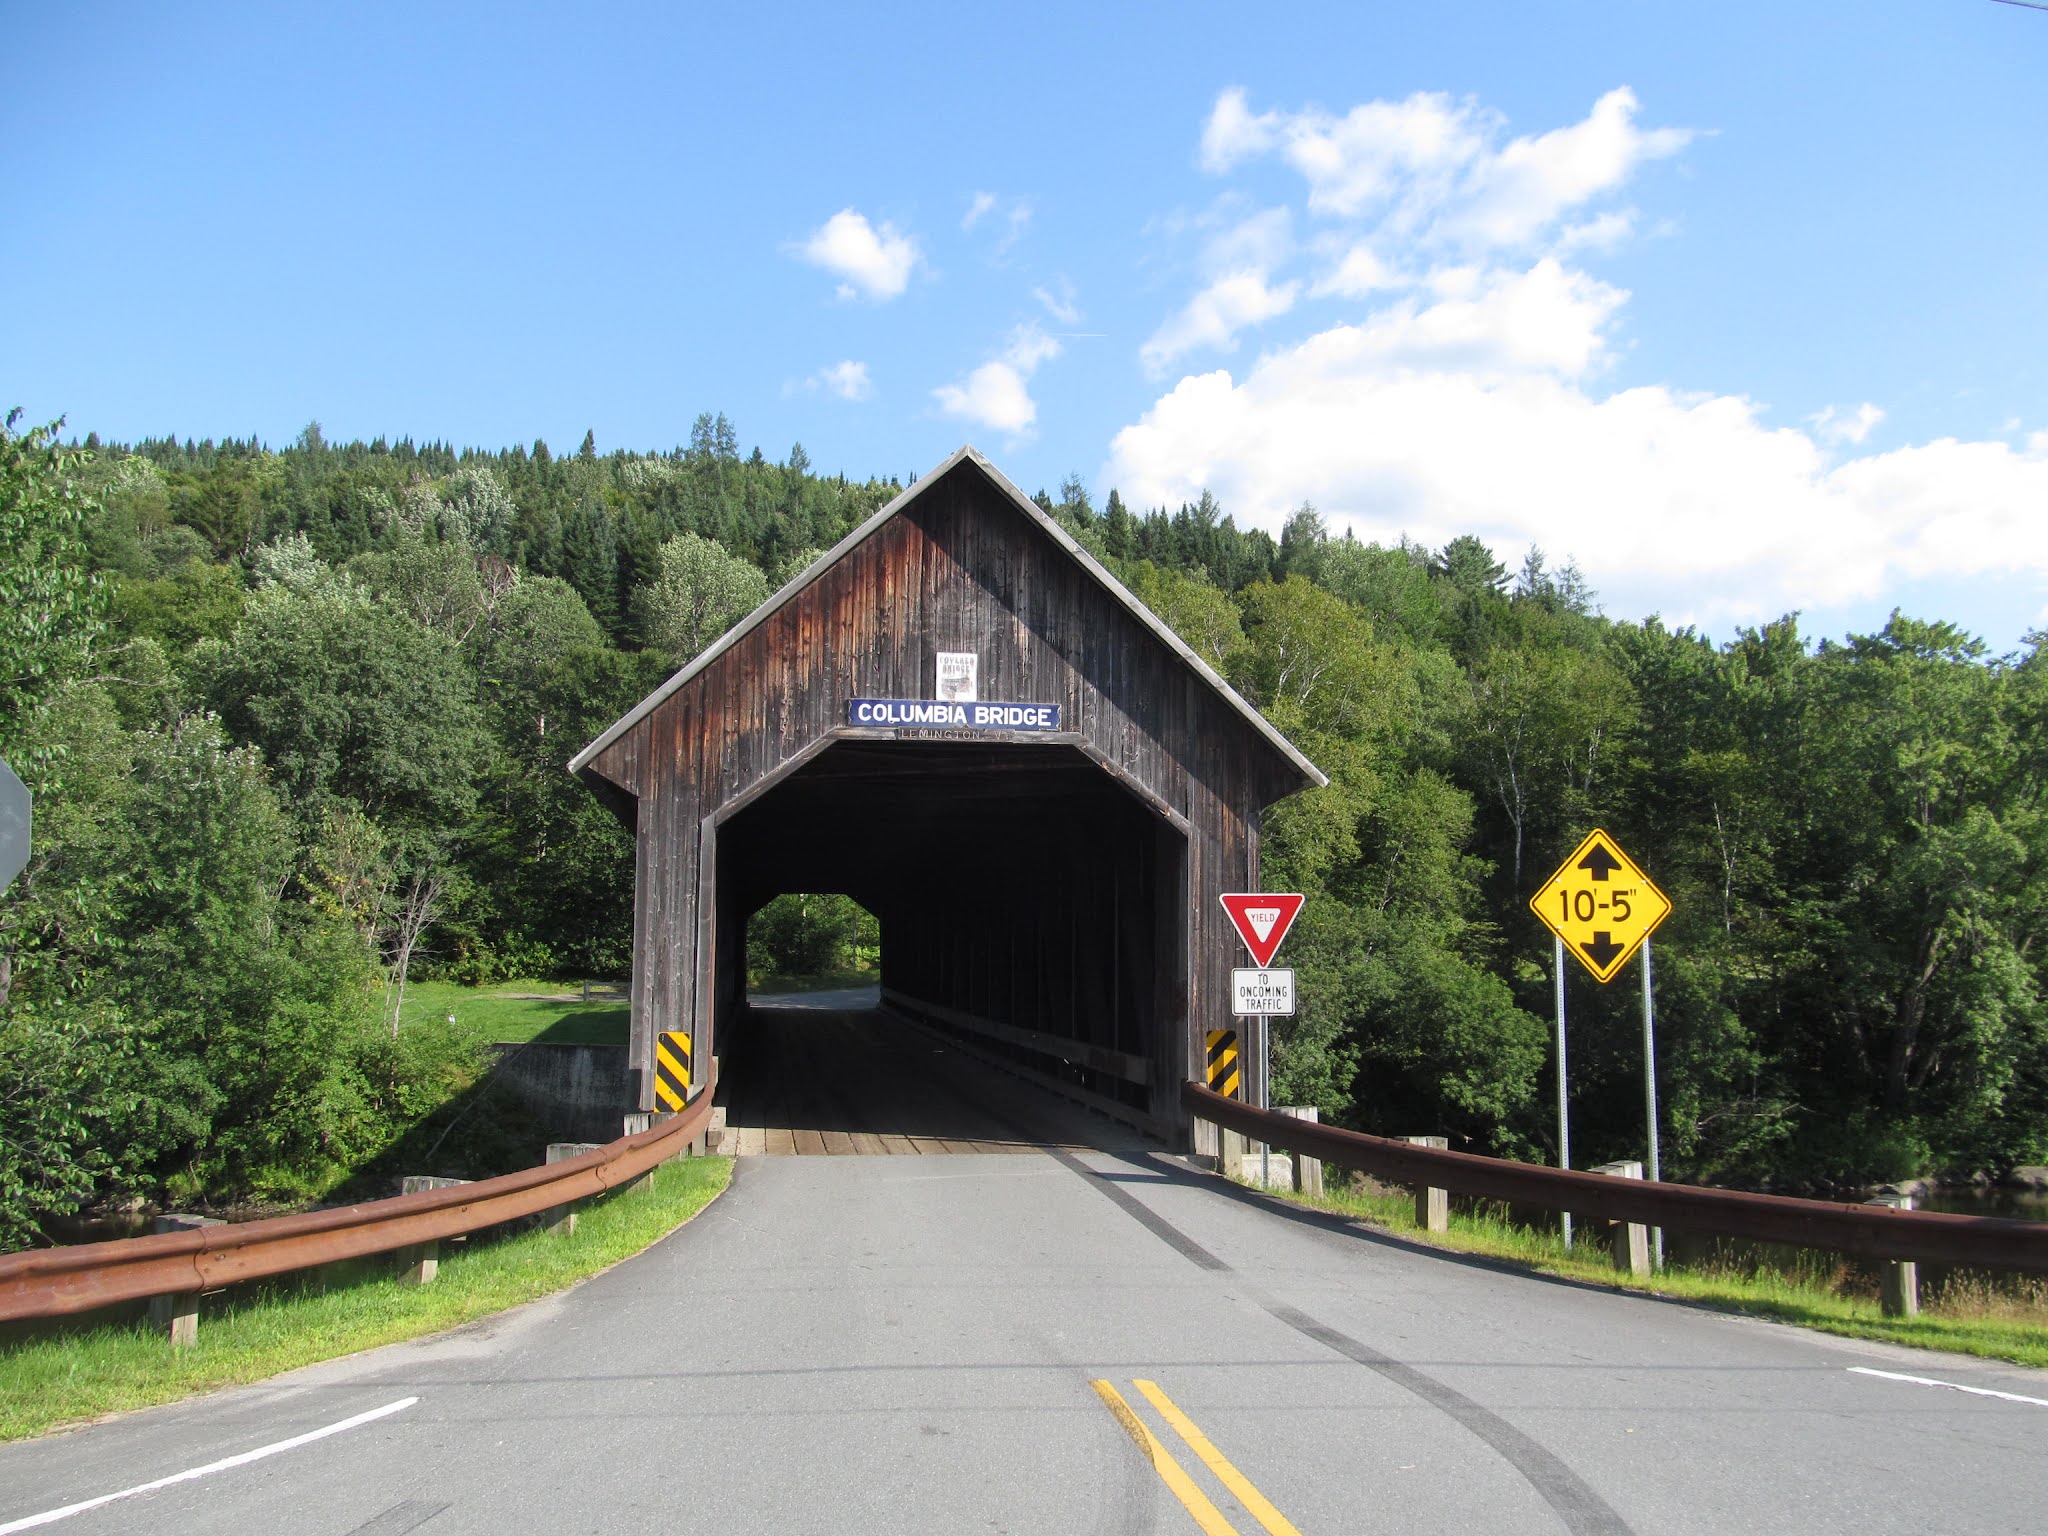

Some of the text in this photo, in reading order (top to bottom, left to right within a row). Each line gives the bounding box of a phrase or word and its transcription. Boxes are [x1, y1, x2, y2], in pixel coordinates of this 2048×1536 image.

[858, 703, 1052, 727] COLUMBIA BRIDGE
[1250, 913, 1275, 923] YIELD
[1258, 973, 1269, 985] TO
[1240, 986, 1288, 998] ONCOMING
[1246, 998, 1282, 1010] TRAFFIC
